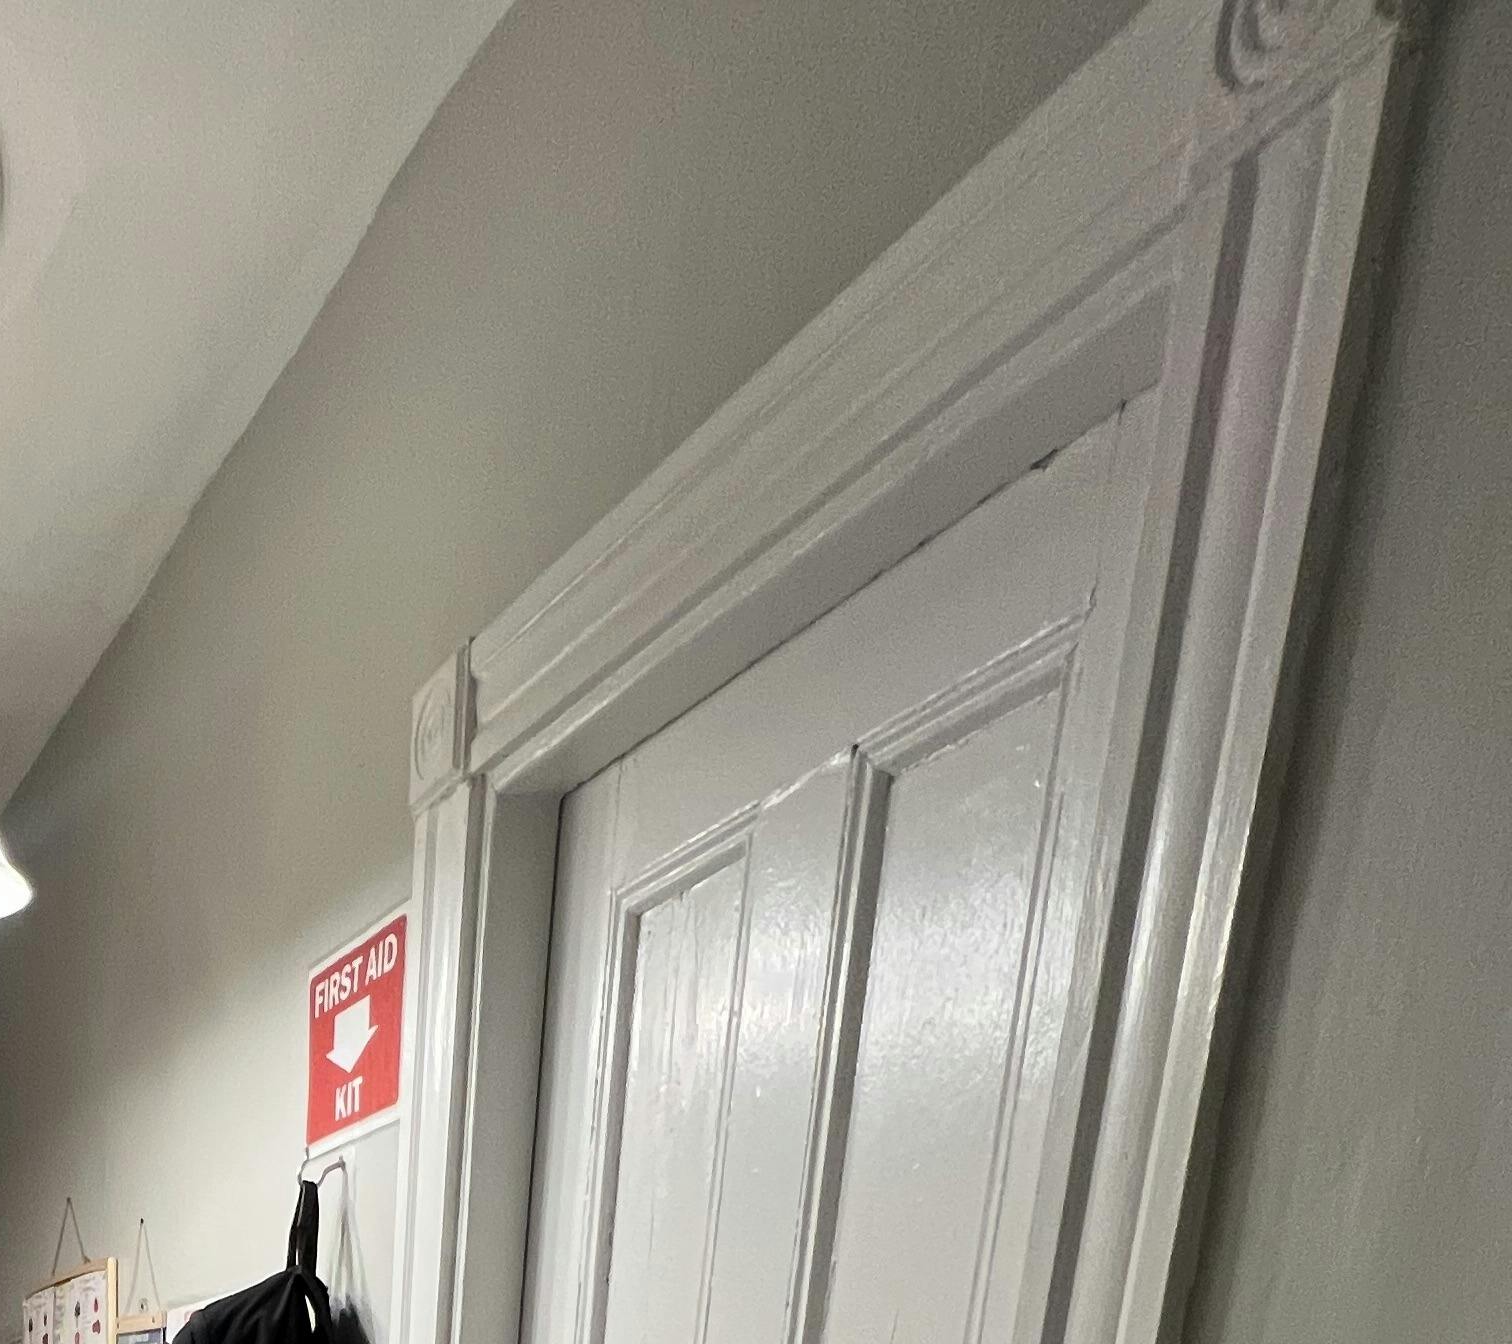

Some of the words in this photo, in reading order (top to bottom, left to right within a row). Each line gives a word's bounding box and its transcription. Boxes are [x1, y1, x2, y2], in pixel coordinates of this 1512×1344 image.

[315, 956, 363, 1018] FIRST
[365, 933, 398, 985] AID
[335, 1076, 363, 1121] KIT
